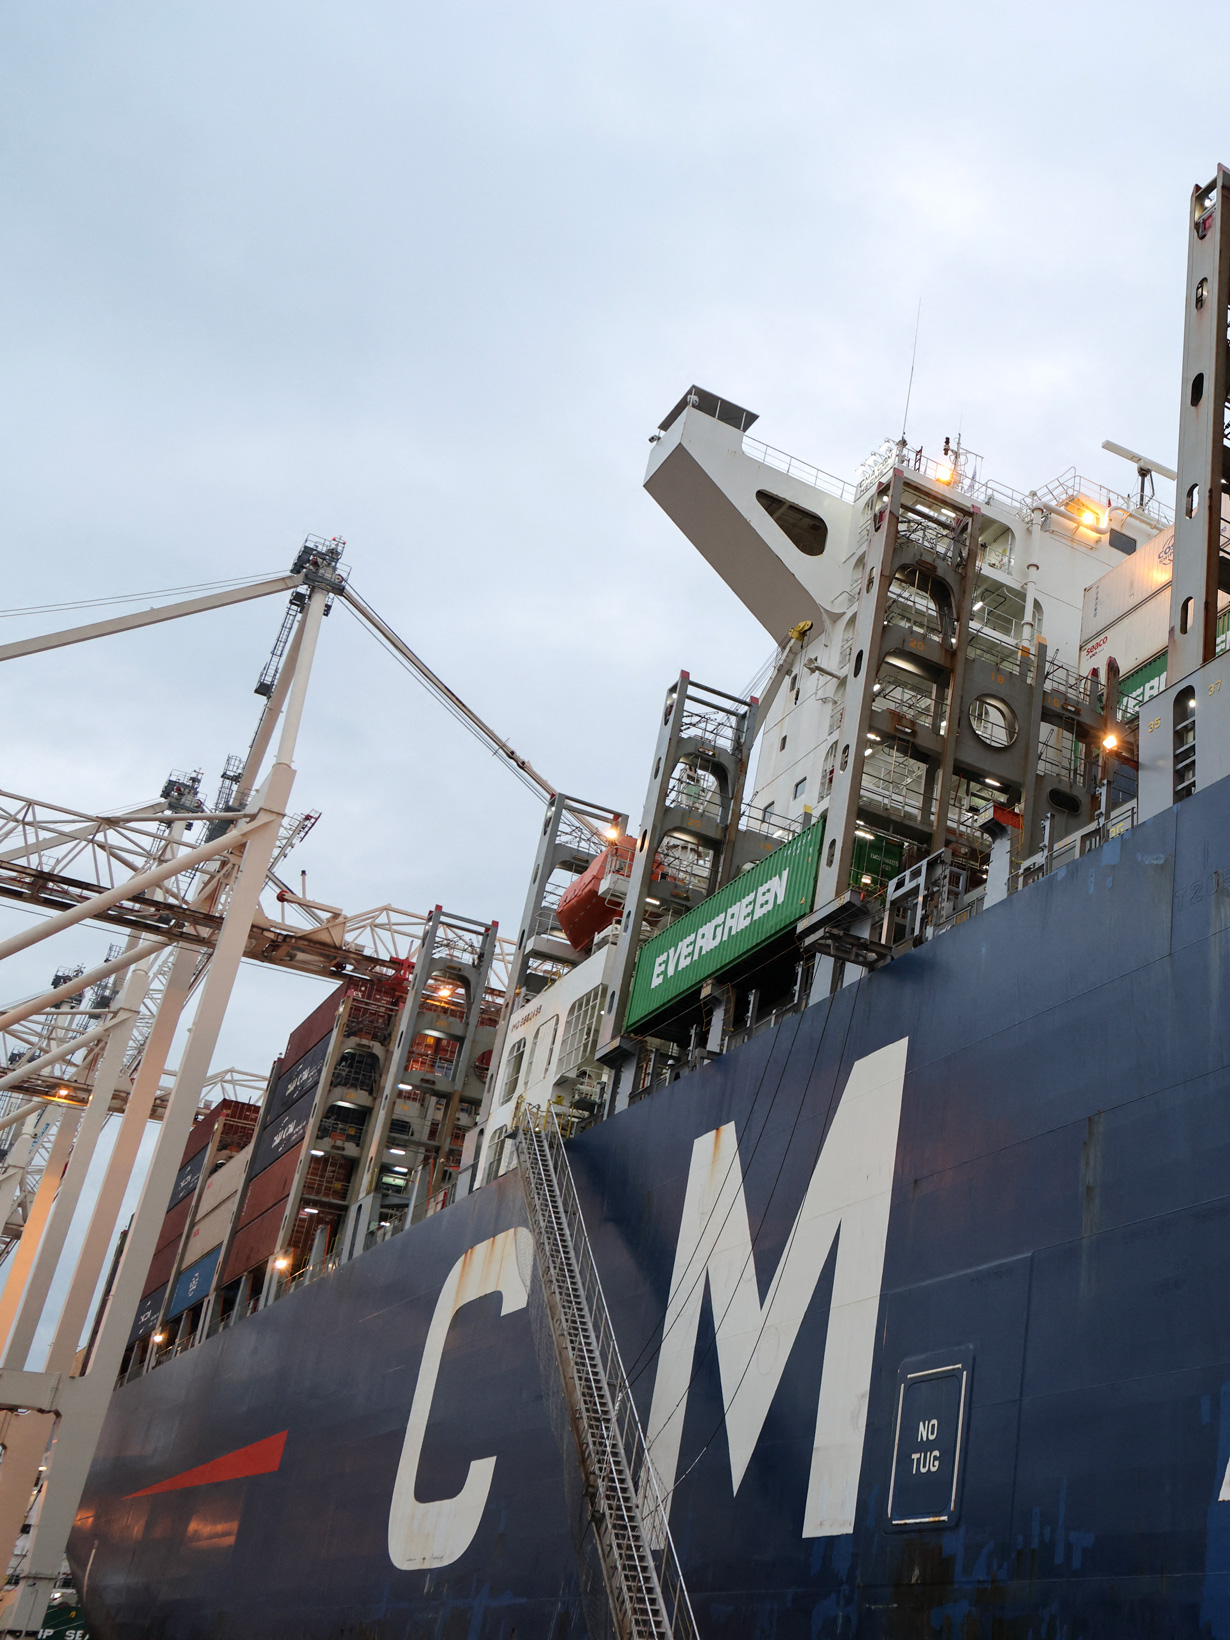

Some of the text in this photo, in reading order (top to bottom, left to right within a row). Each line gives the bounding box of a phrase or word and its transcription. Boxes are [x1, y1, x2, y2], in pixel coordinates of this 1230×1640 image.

[908, 637, 925, 652] 20
[1085, 636, 1108, 657] seaco
[990, 671, 1005, 685] 18
[1207, 679, 1222, 697] 37
[1147, 716, 1161, 733] 35
[687, 817, 702, 829] 20
[650, 867, 789, 989] EVERGREEN
[917, 1418, 938, 1442] NO
[911, 1450, 940, 1475] TUG
